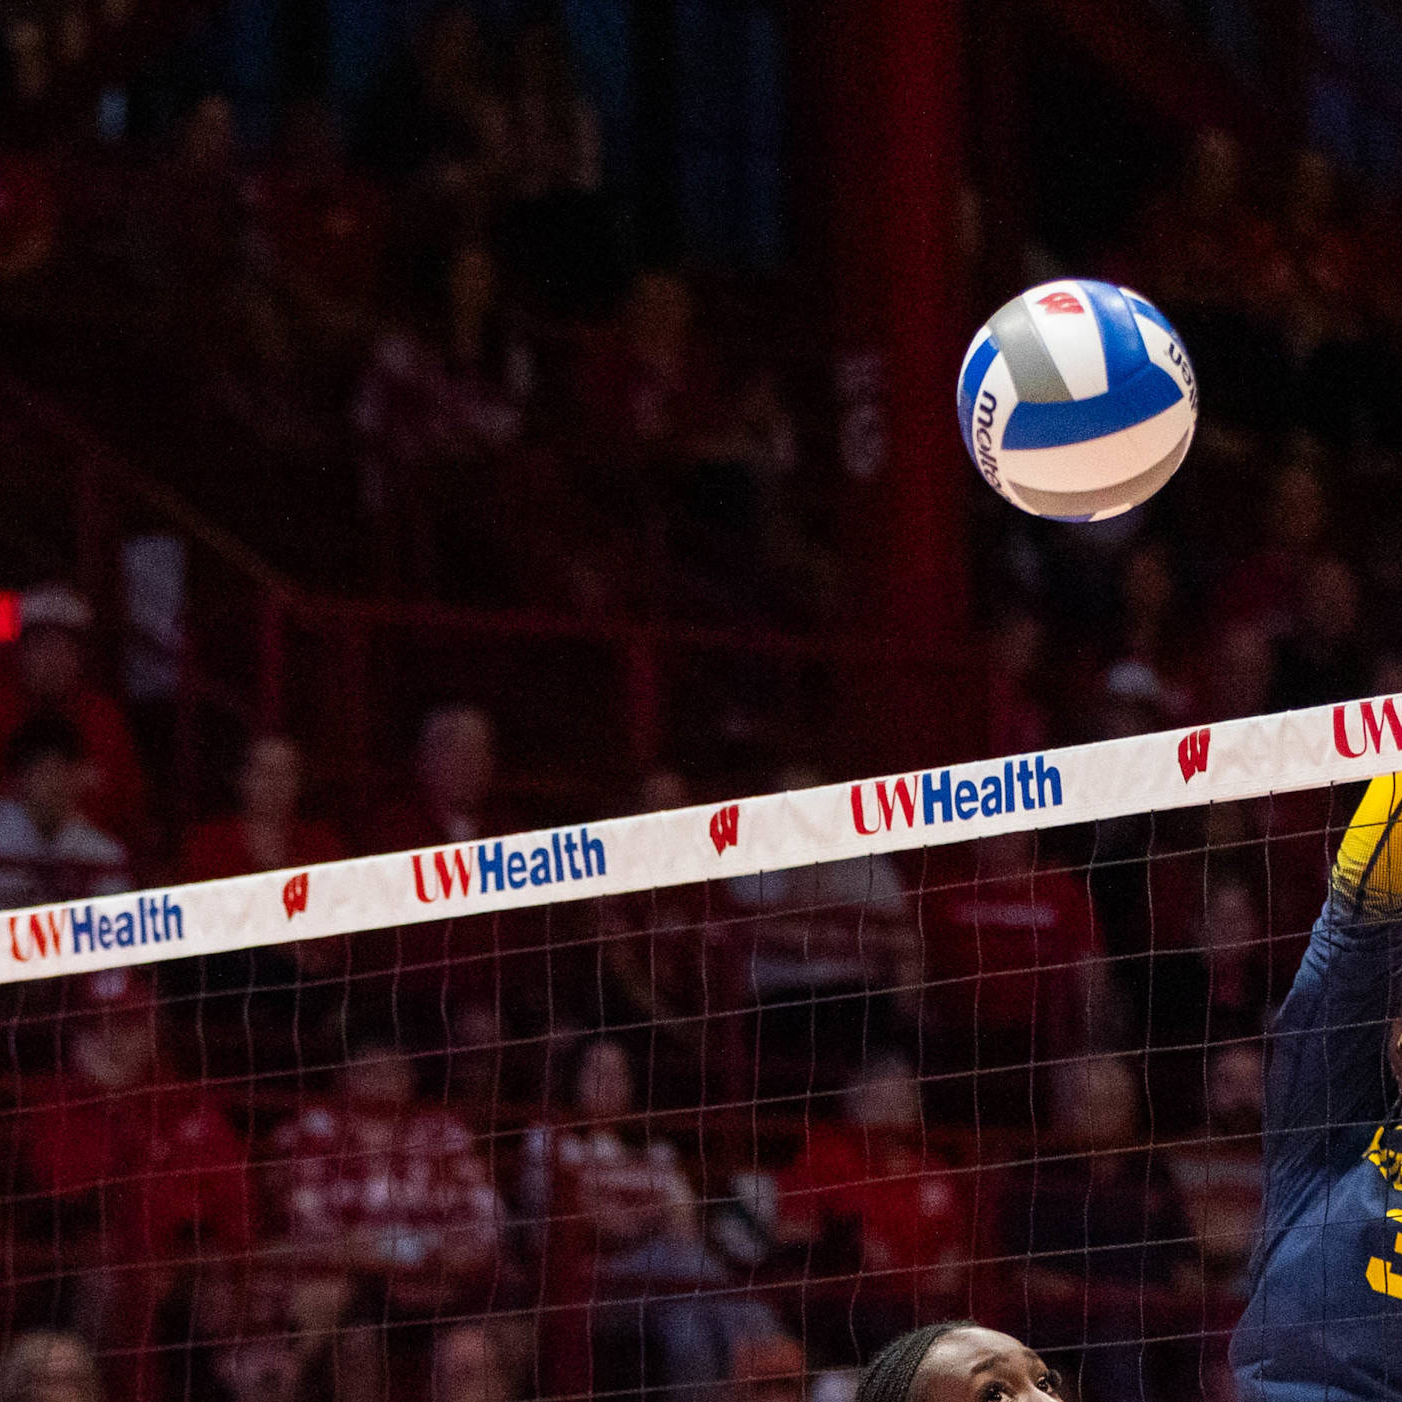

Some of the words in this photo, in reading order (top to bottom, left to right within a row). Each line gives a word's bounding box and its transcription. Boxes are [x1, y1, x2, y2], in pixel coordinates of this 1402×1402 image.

[849, 754, 1063, 837] UWHealth
[412, 826, 606, 905] UWHealth
[8, 895, 184, 963] UWHealth
